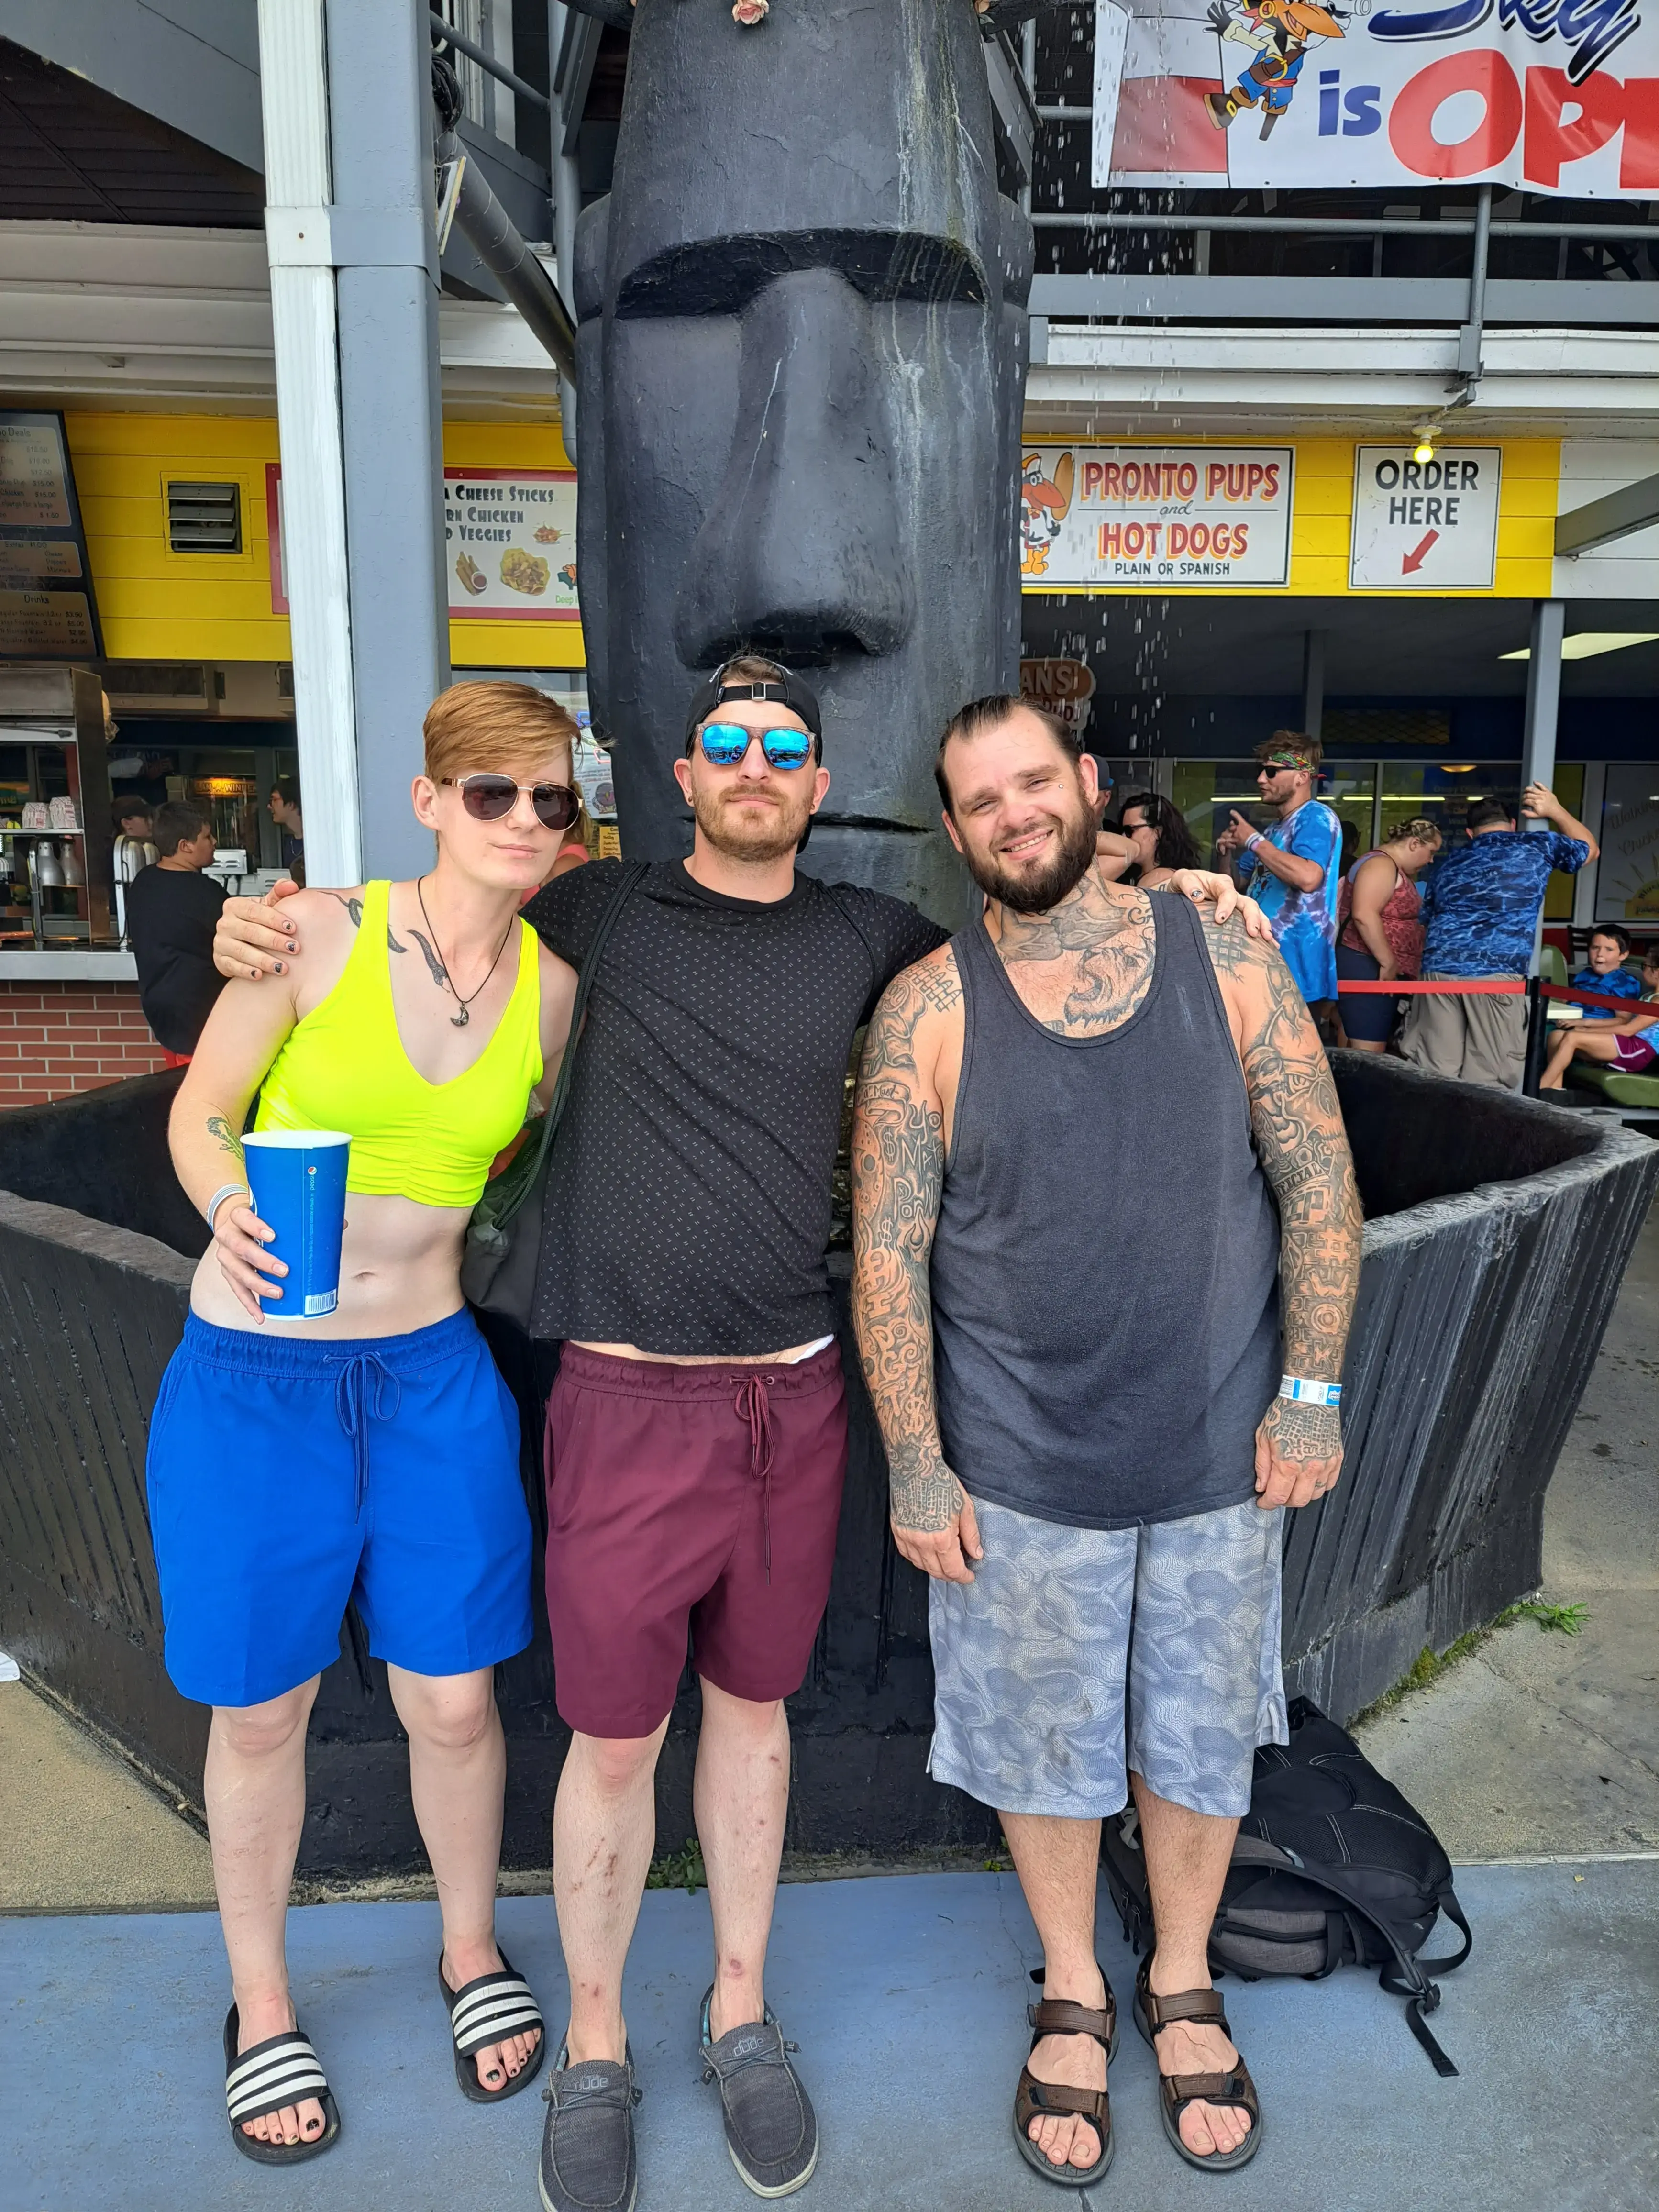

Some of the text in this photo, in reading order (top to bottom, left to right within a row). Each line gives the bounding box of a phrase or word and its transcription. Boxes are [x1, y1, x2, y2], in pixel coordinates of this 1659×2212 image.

[1319, 70, 1381, 137] is
[8, 427, 31, 437] Deals
[1082, 462, 1280, 501] PRONTO PUPS
[1375, 459, 1480, 491] ORDER
[1159, 500, 1193, 516] and
[1389, 497, 1460, 526] HERE
[1099, 523, 1249, 559] HOT DOGS
[1115, 563, 1230, 575] PLAIN OR SPANISH
[24, 594, 50, 604] Drinks
[555, 595, 574, 605] Deep
[733, 2036, 764, 2057] dude
